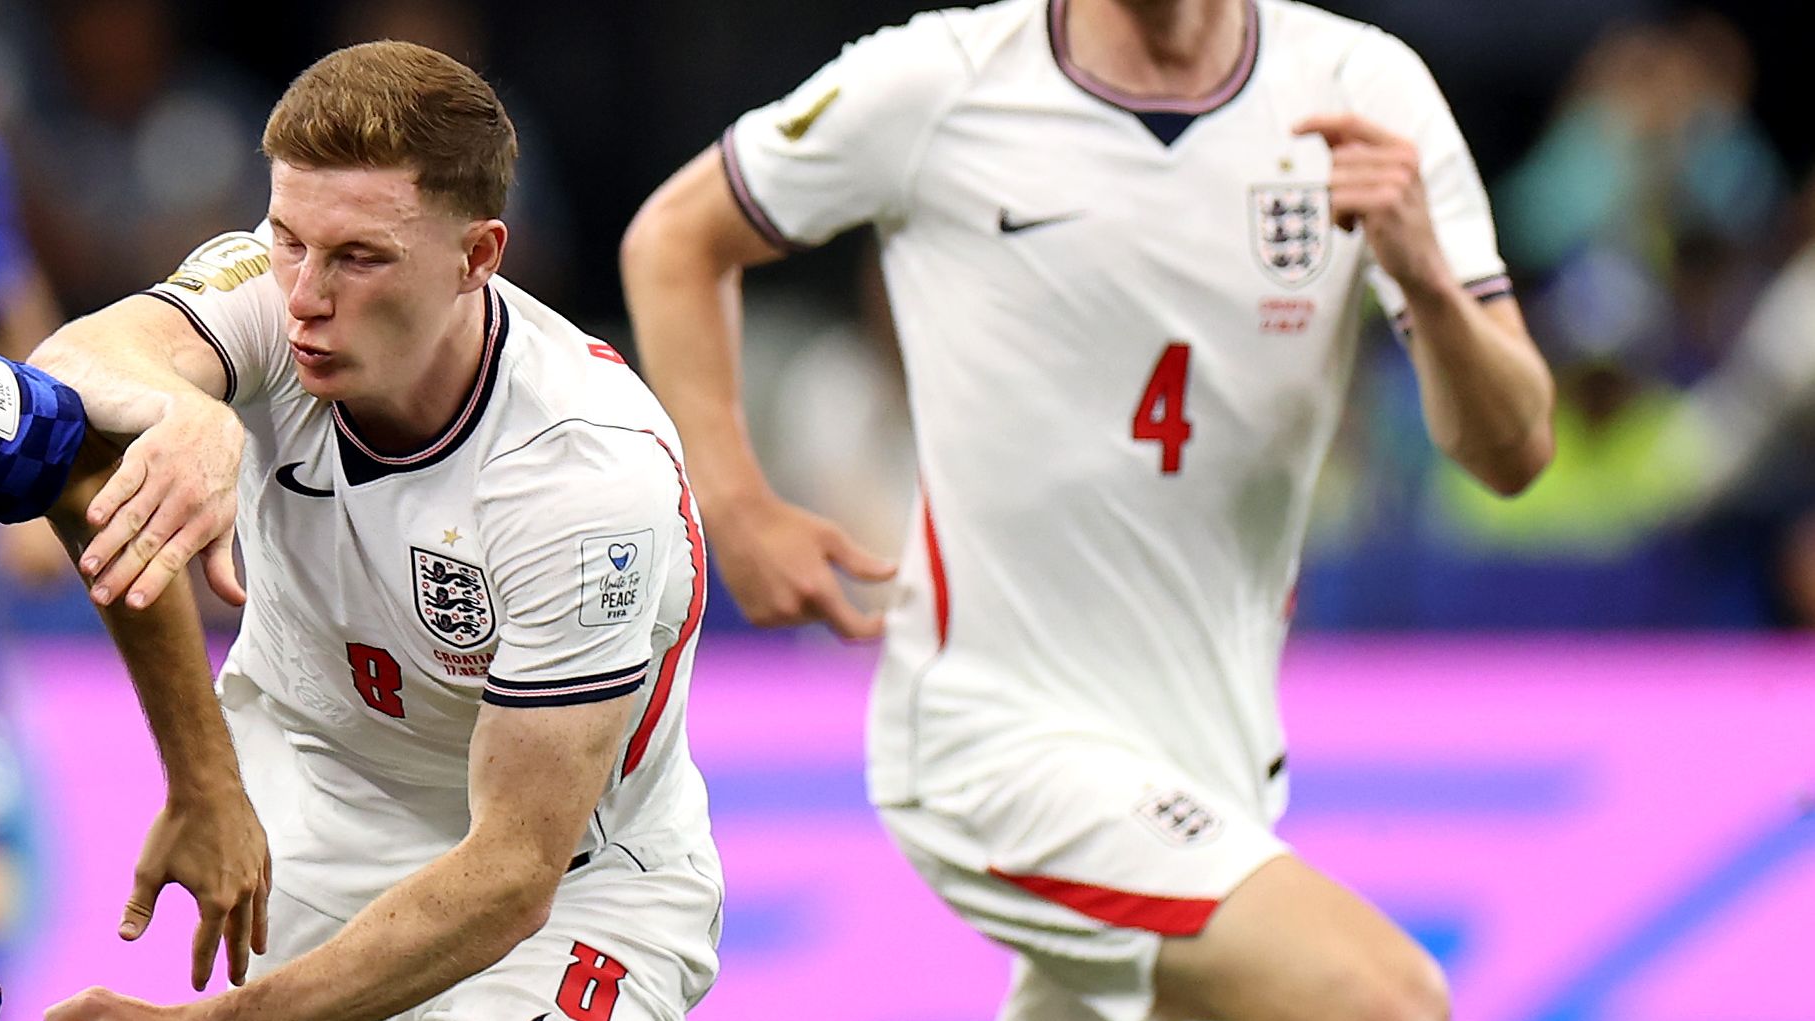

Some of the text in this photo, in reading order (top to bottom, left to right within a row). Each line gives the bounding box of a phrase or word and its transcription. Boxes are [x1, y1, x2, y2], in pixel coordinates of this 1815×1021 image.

[1132, 342, 1192, 473] 4
[601, 589, 637, 609] PEACE
[607, 609, 628, 619] FIFA
[433, 649, 494, 665] CROATIA
[443, 664, 489, 677] 17.06.2
[346, 641, 405, 719] 8
